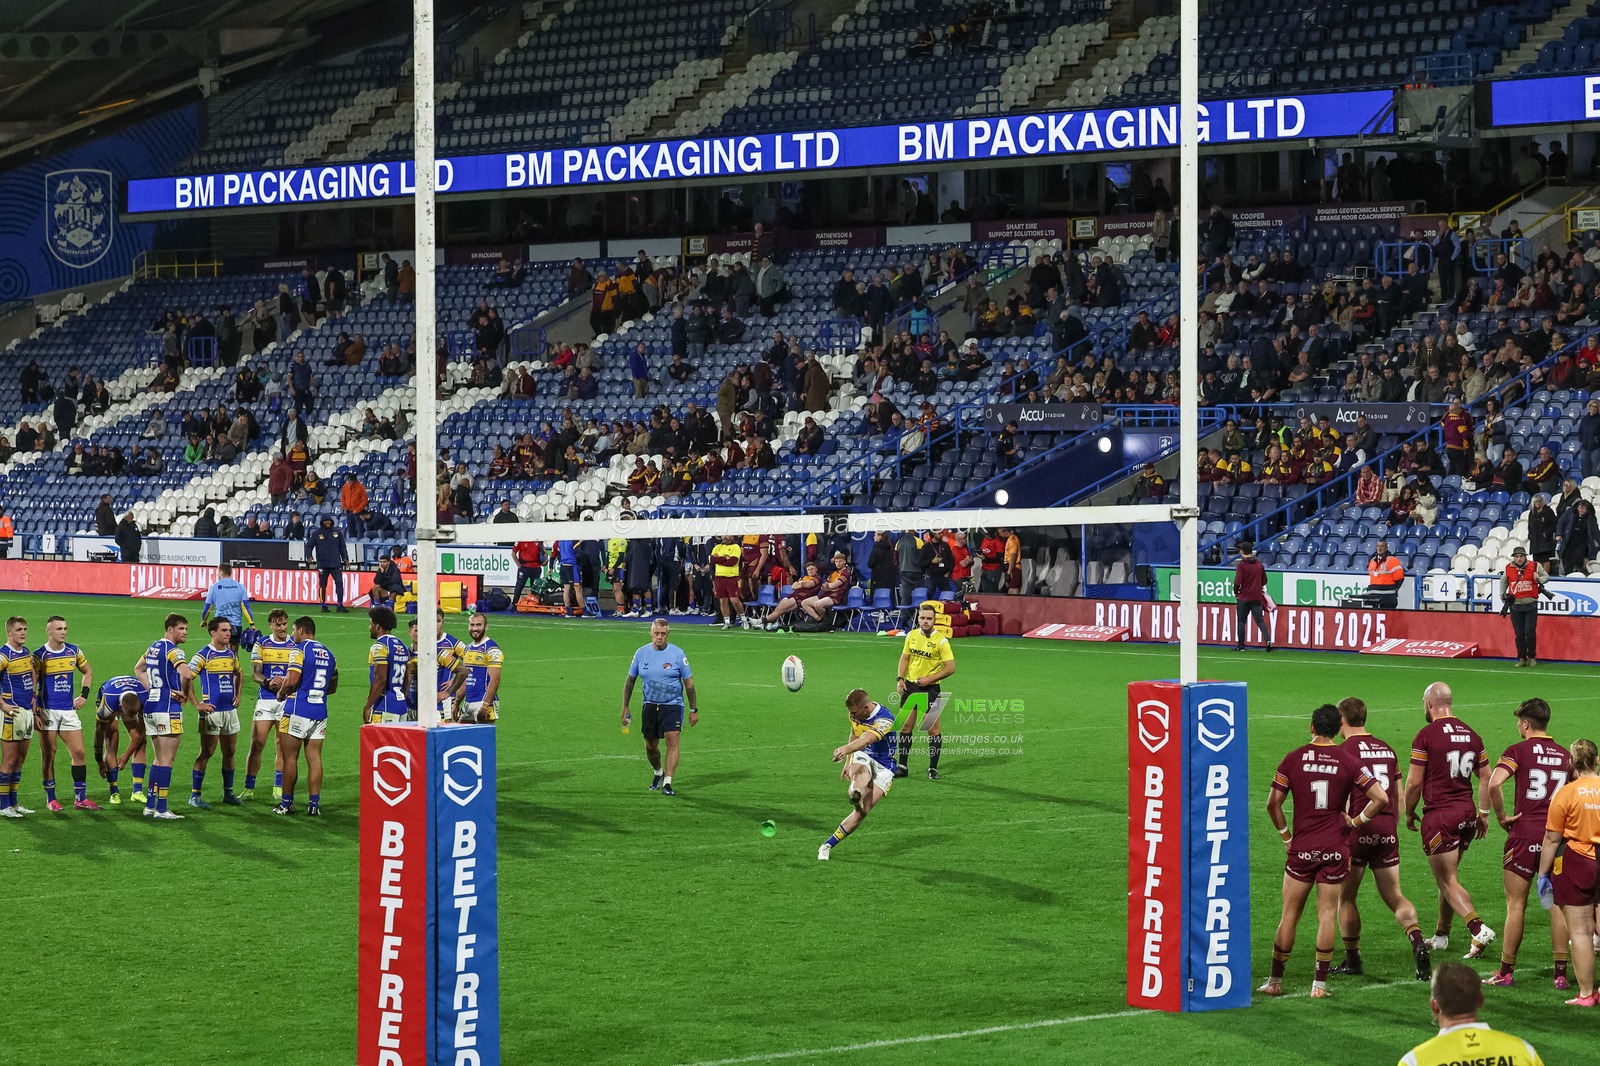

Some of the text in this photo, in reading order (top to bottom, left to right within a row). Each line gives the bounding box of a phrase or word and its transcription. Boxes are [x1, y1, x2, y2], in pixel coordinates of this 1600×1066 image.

[899, 122, 954, 162] BM
[1226, 97, 1306, 140] LTD
[506, 131, 840, 187] BM PACKAGING LTD
[175, 158, 454, 209] BM PACKAGING LD
[46, 538, 51, 549] 7
[167, 554, 186, 562] BUILDING
[186, 555, 207, 563] PRODUCTS
[411, 549, 418, 561] 6
[458, 553, 510, 572] heatable
[1440, 581, 1449, 596] 4
[587, 602, 600, 613] 10
[1576, 599, 1593, 613] it
[1064, 625, 1118, 635] GLEN'S
[1095, 602, 1142, 638] BOOK
[1288, 609, 1325, 646] FOR
[1334, 611, 1387, 648] 2025
[1405, 640, 1465, 651] GLEN'S
[1405, 648, 1447, 656] VODKA
[146, 667, 163, 689] 16
[313, 668, 327, 689] 5
[1450, 735, 1471, 743] KING
[1446, 750, 1476, 779] 16
[1537, 756, 1562, 766] LAND
[1525, 768, 1569, 801] 37
[1577, 787, 1600, 798] PHY
[1310, 779, 1329, 810] 1
[1140, 765, 1164, 998] BETFRED
[1204, 763, 1233, 998] BETFRED
